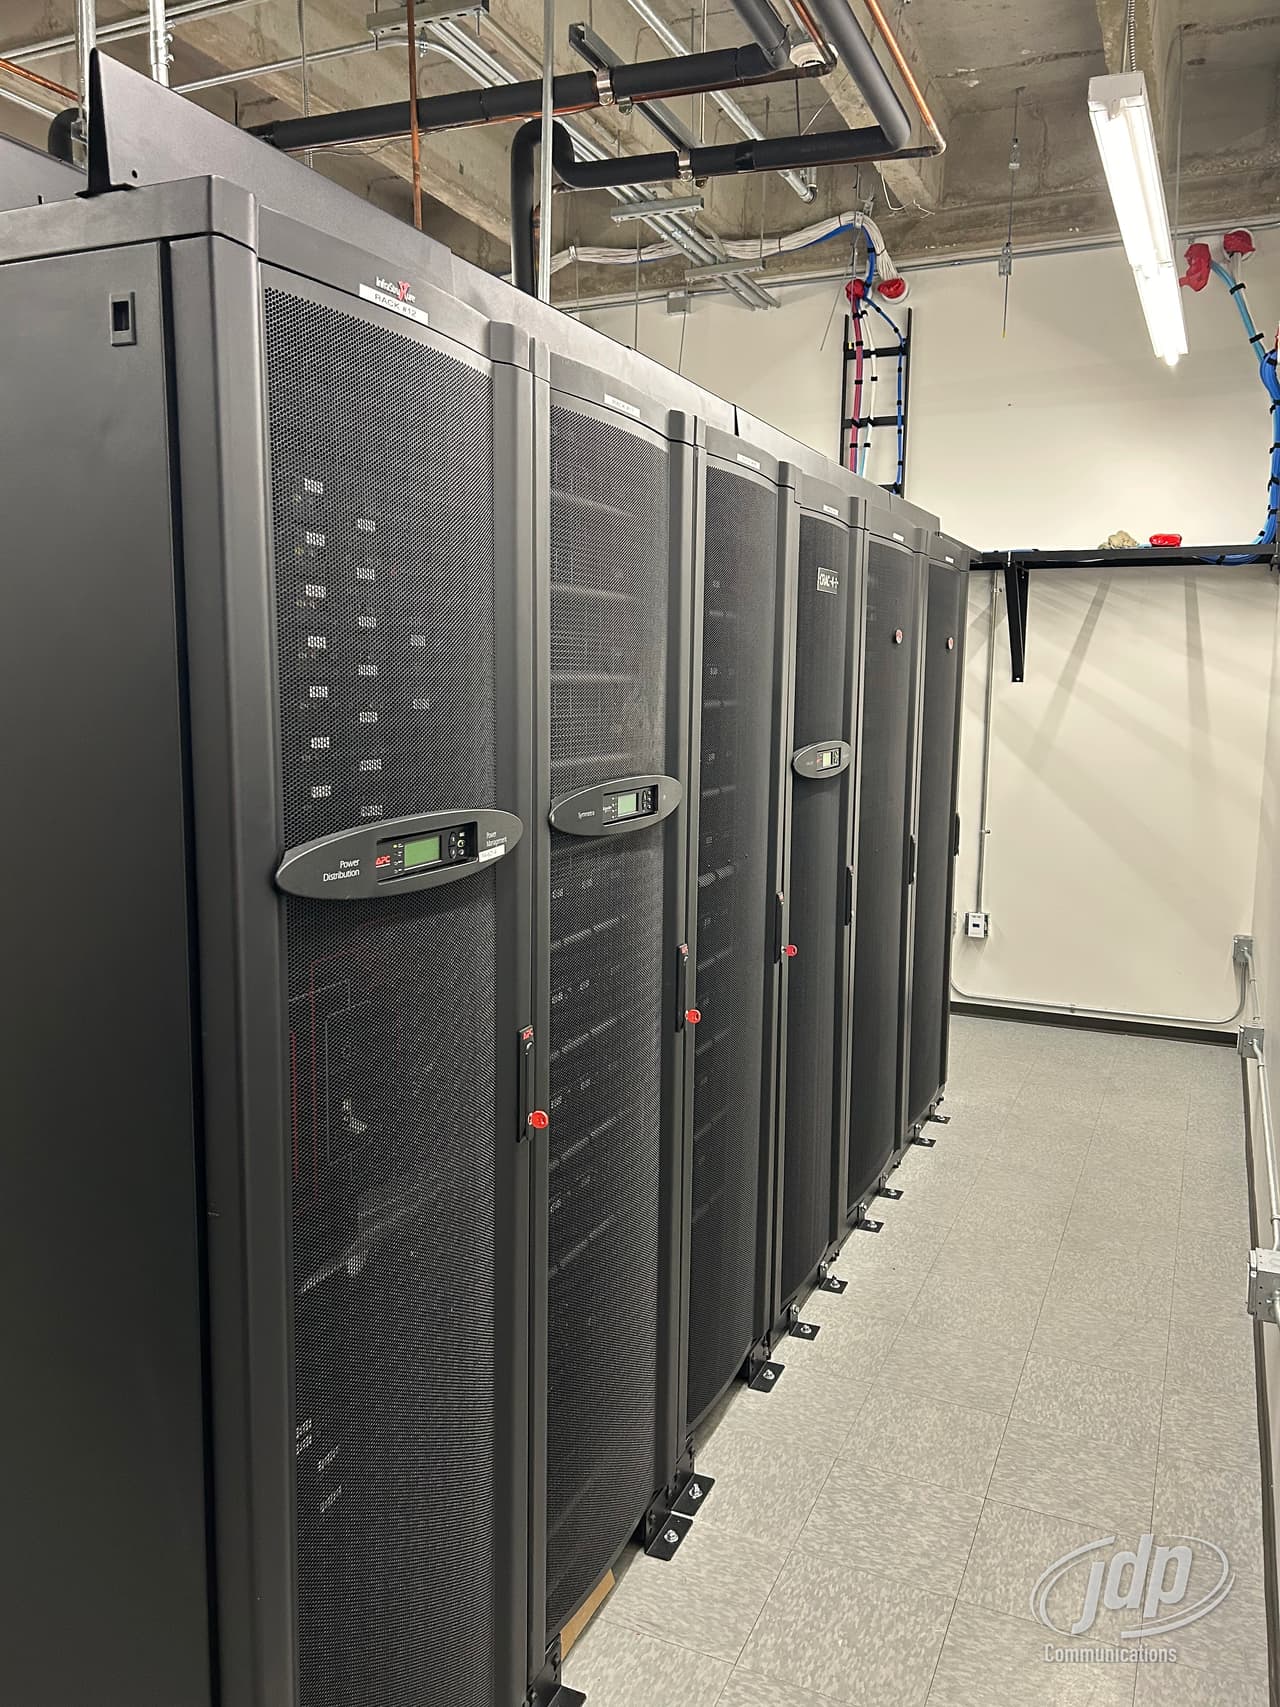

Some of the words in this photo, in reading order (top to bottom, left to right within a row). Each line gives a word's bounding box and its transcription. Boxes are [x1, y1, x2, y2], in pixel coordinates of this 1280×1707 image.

[375, 293, 400, 310] RACK
[339, 859, 360, 869] Power
[376, 855, 391, 866] APC
[323, 869, 360, 882] Distribution
